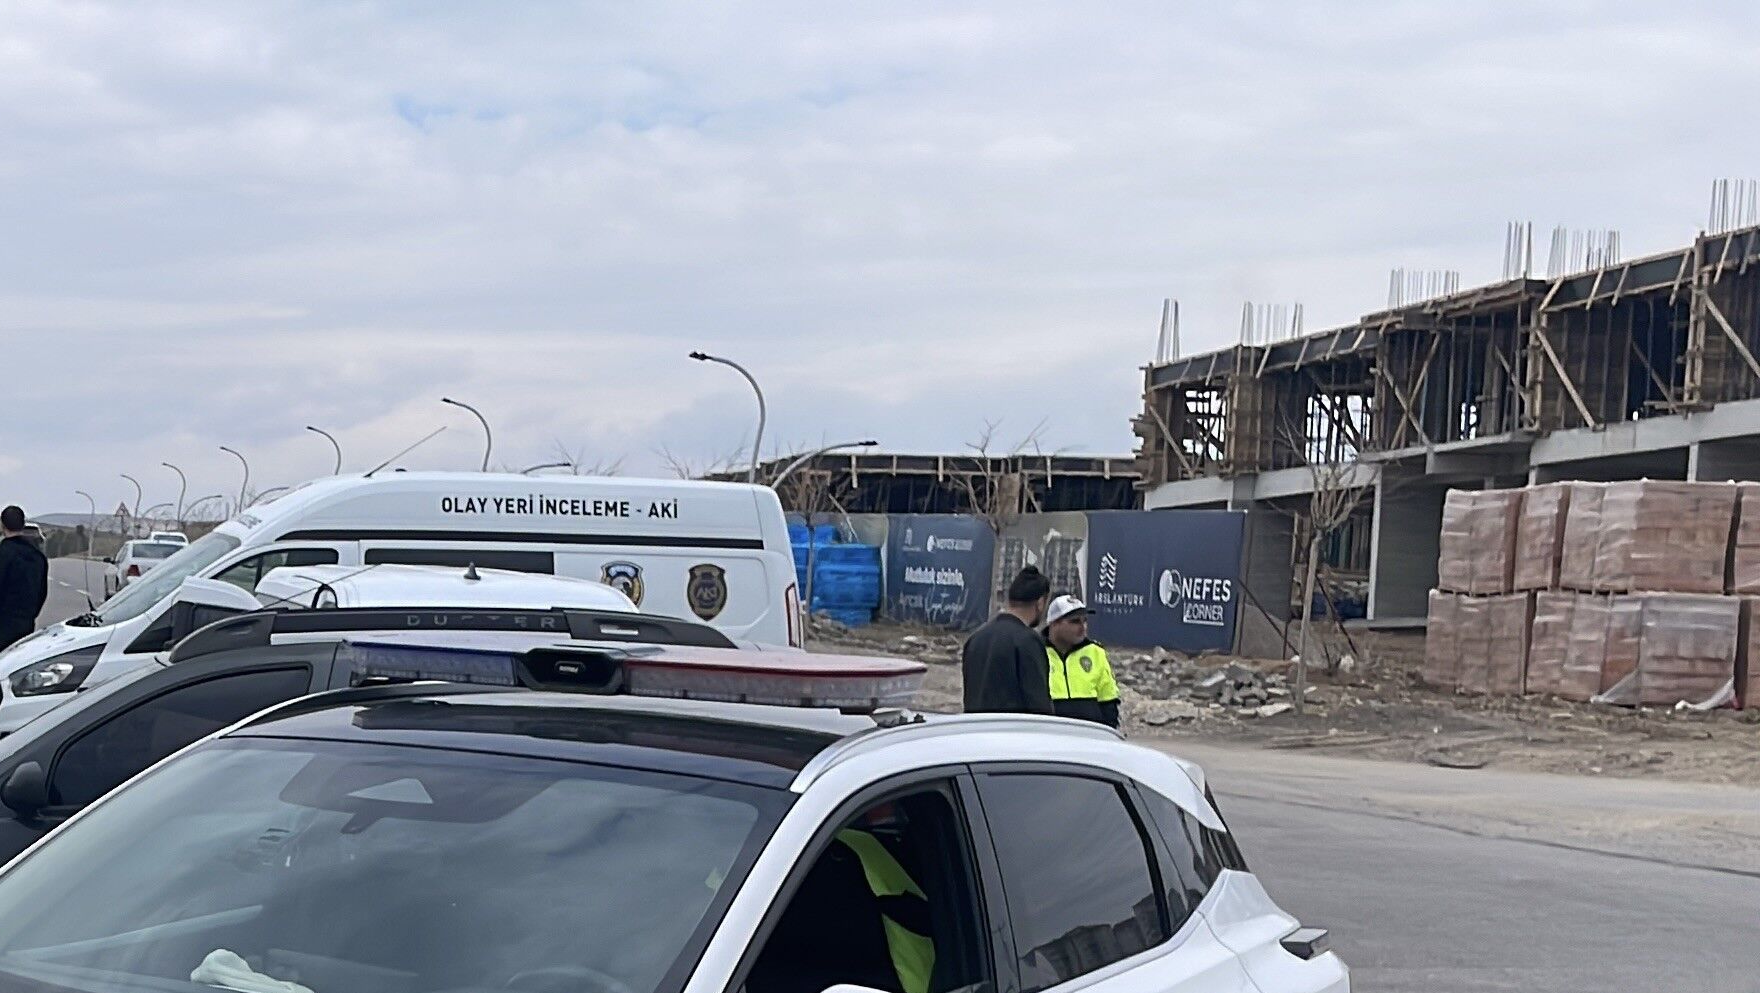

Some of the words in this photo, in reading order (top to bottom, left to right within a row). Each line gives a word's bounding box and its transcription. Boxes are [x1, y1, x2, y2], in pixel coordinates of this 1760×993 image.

[441, 497, 488, 513] OLAY
[493, 494, 534, 514] YERİ
[539, 494, 630, 517] İNCELEME
[648, 498, 678, 518] AKİ
[1181, 577, 1232, 602] NEFES
